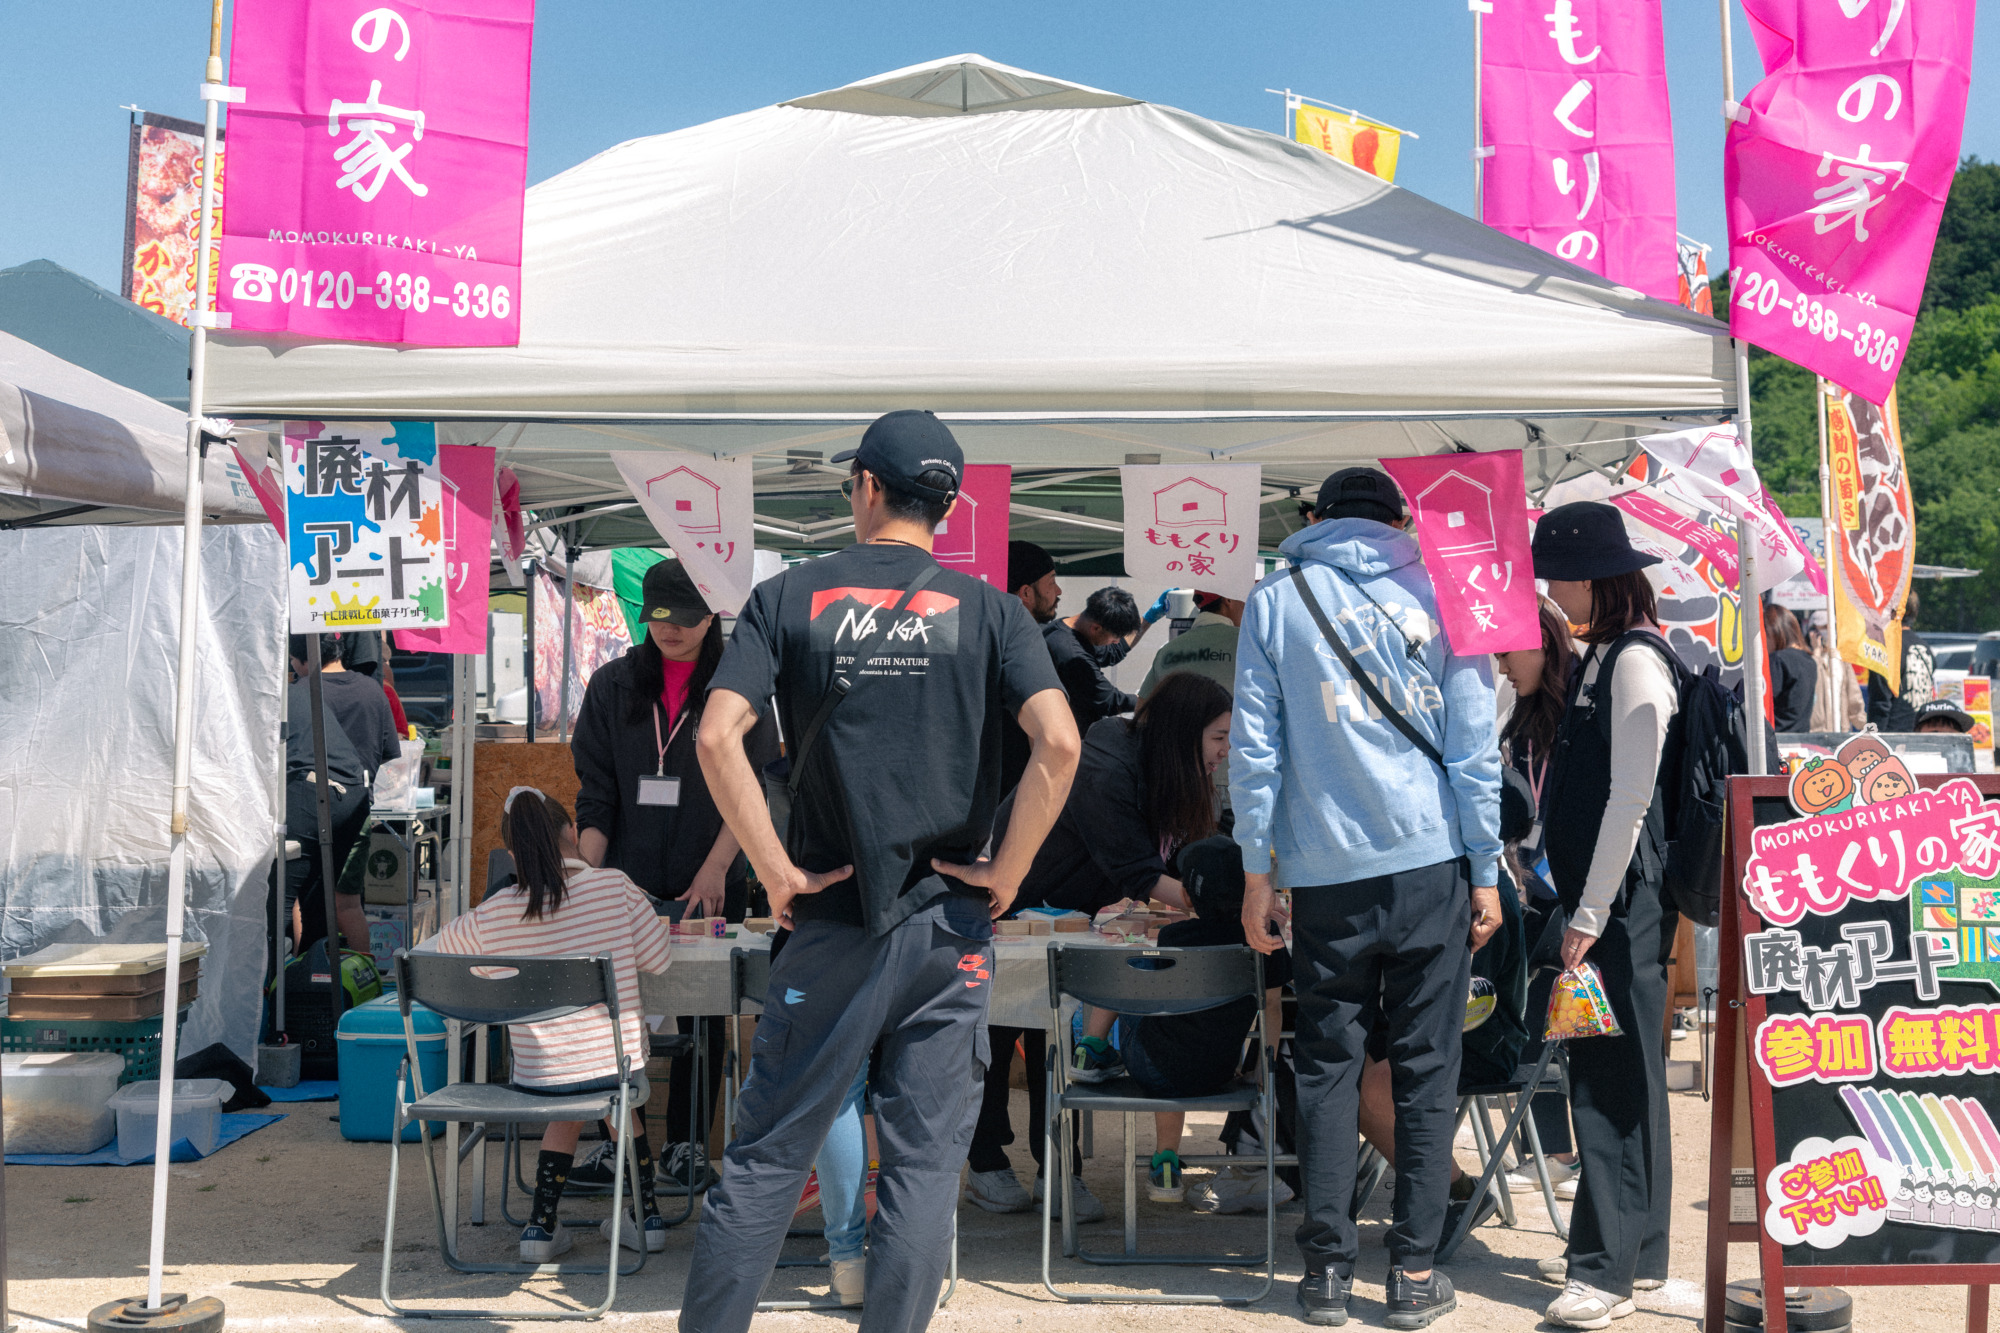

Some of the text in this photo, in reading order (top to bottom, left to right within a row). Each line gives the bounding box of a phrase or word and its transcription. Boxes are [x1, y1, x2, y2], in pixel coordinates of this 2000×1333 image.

[329, 8, 428, 202] の家
[1315, 116, 1334, 156] VE
[268, 229, 478, 261] MOMOKURIKAKI-YA
[279, 268, 511, 319] 0120-338-336
[305, 436, 423, 520] 廃材
[304, 523, 430, 600] アート
[1144, 528, 1239, 553] ももくり
[1166, 552, 1216, 576] の家
[892, 657, 930, 666] NATURE
[1198, 647, 1232, 662] Klein
[1761, 787, 1974, 851] MOMOKURIKAKI-YA
[1756, 804, 2000, 916] ももくりの家
[1749, 925, 1956, 1006] 廃材アート
[1766, 1024, 1866, 1076] 参加
[1783, 1151, 1865, 1197] ご参加
